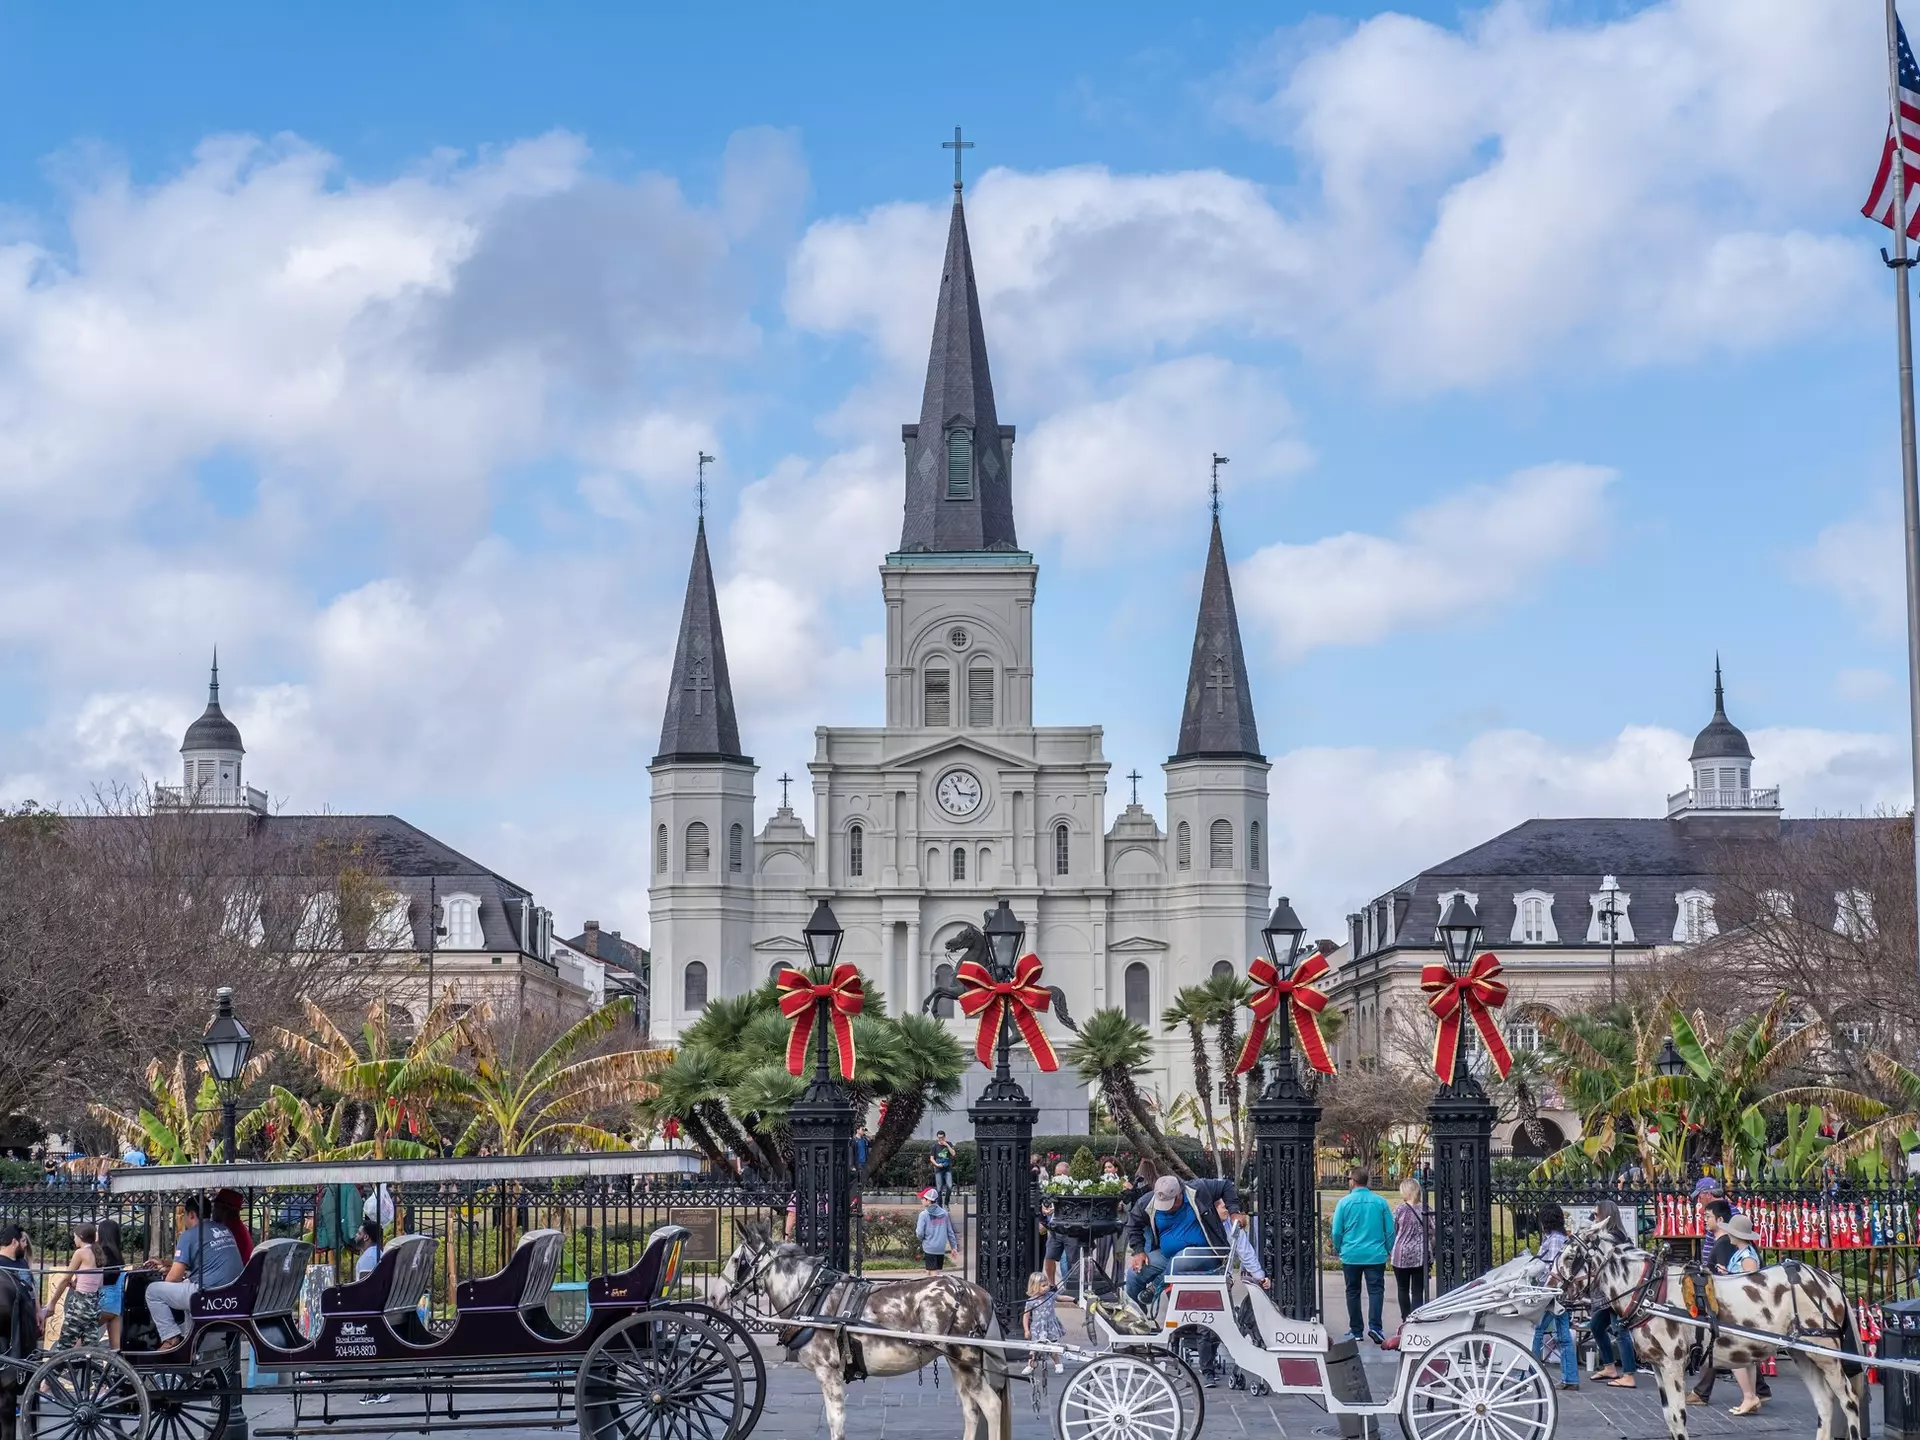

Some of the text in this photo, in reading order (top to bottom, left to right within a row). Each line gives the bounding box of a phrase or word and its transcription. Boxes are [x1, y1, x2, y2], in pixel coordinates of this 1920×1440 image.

[1181, 1311, 1215, 1324] AC 23
[1275, 1331, 1318, 1345] ROLLIN
